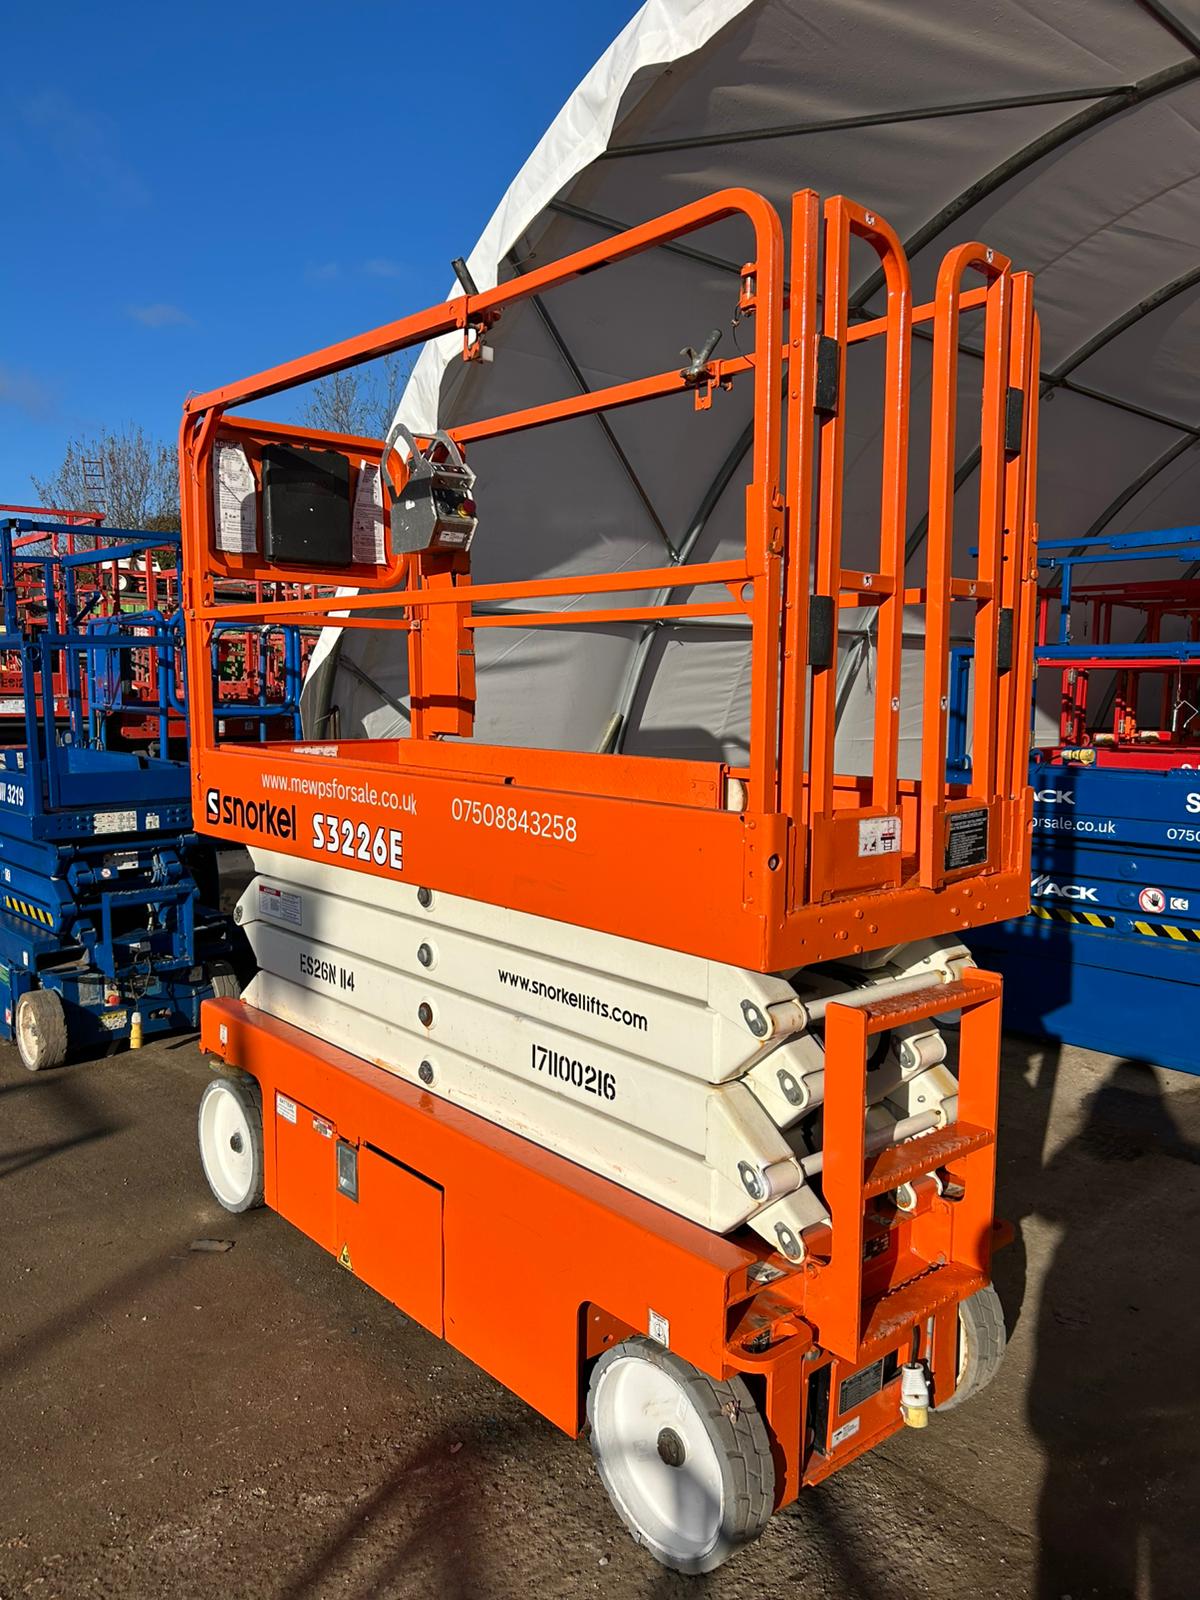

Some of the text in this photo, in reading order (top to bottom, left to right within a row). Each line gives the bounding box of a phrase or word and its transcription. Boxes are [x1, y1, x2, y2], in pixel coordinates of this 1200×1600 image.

[7, 783, 24, 806] 3219
[261, 773, 417, 815] www.mewpsforsale.co.uk
[223, 795, 297, 841] snorkel
[451, 797, 577, 842] 07508843258
[312, 812, 404, 871] S3226E
[300, 953, 355, 991] ES26N 114
[498, 969, 648, 1031] www.snorkellifts.com
[531, 1044, 616, 1101] 171100216
